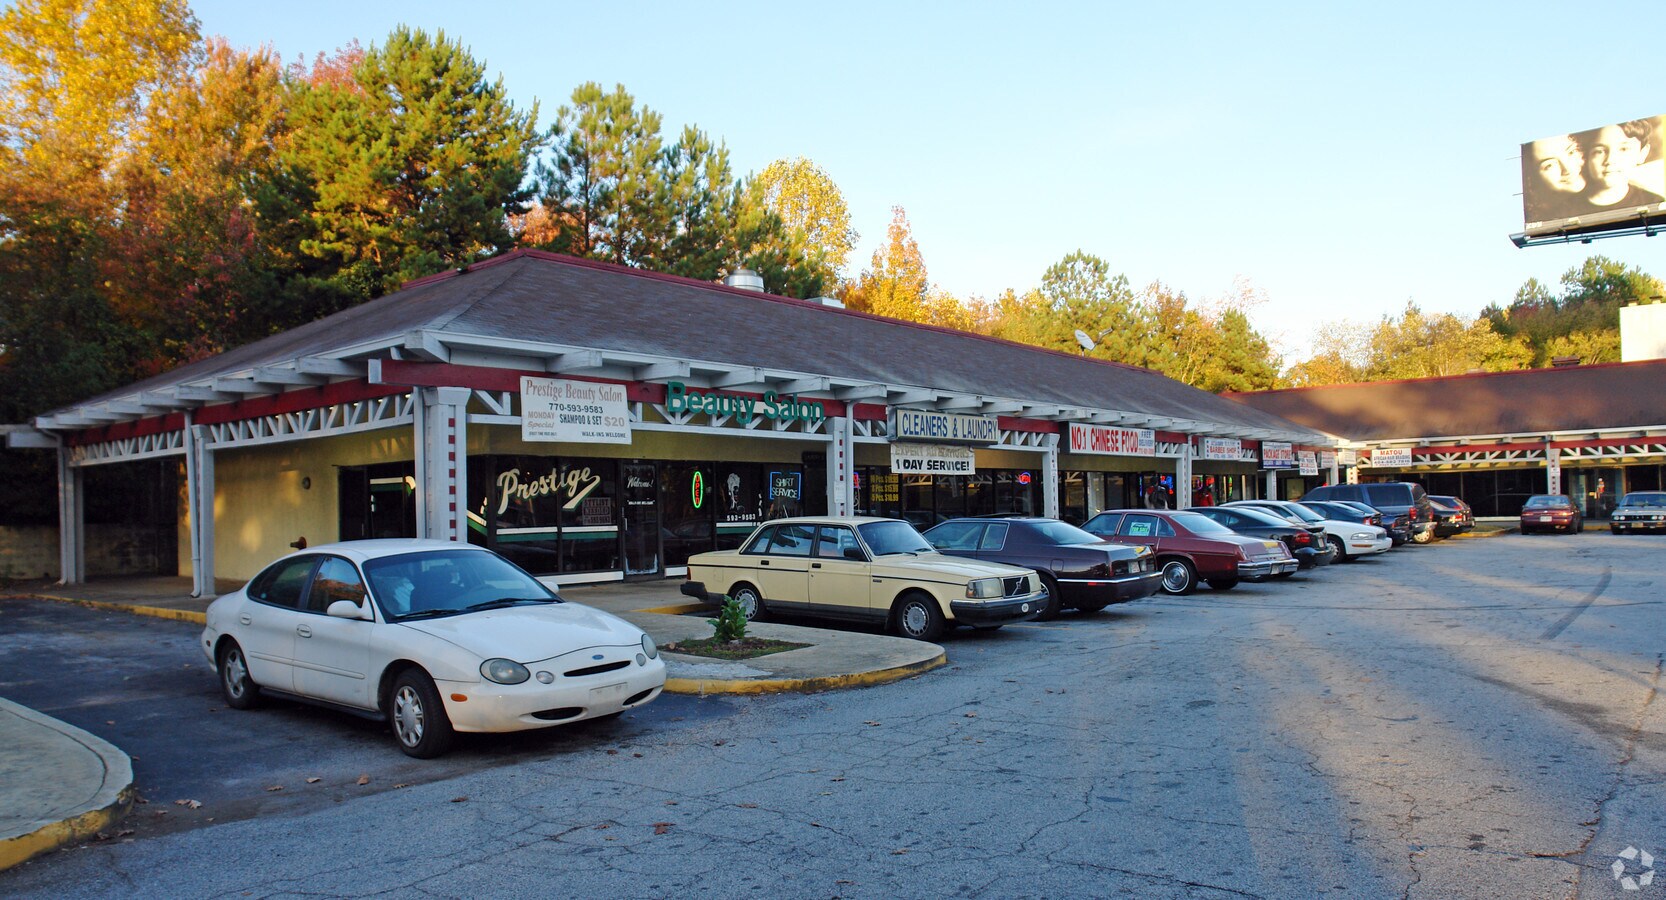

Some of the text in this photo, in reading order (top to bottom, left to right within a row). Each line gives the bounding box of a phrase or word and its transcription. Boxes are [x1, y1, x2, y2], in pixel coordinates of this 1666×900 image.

[525, 379, 622, 404] Prestige Beauty Salon
[548, 402, 604, 414] 770-593-9583
[667, 381, 824, 425] Beauty Salon
[527, 411, 555, 419] MONDAY
[559, 413, 586, 425] SHAMPOO
[587, 415, 591, 425] &
[592, 416, 602, 425] SET
[527, 420, 555, 429] Special
[902, 413, 998, 439] CLEANERS & LAUNDRY
[1071, 426, 1139, 453] NO.1 CHINESE FOOD
[896, 459, 970, 471] 1 DAY SERVICE!
[497, 467, 600, 514] Prestige
[771, 487, 798, 499] SERVICE
